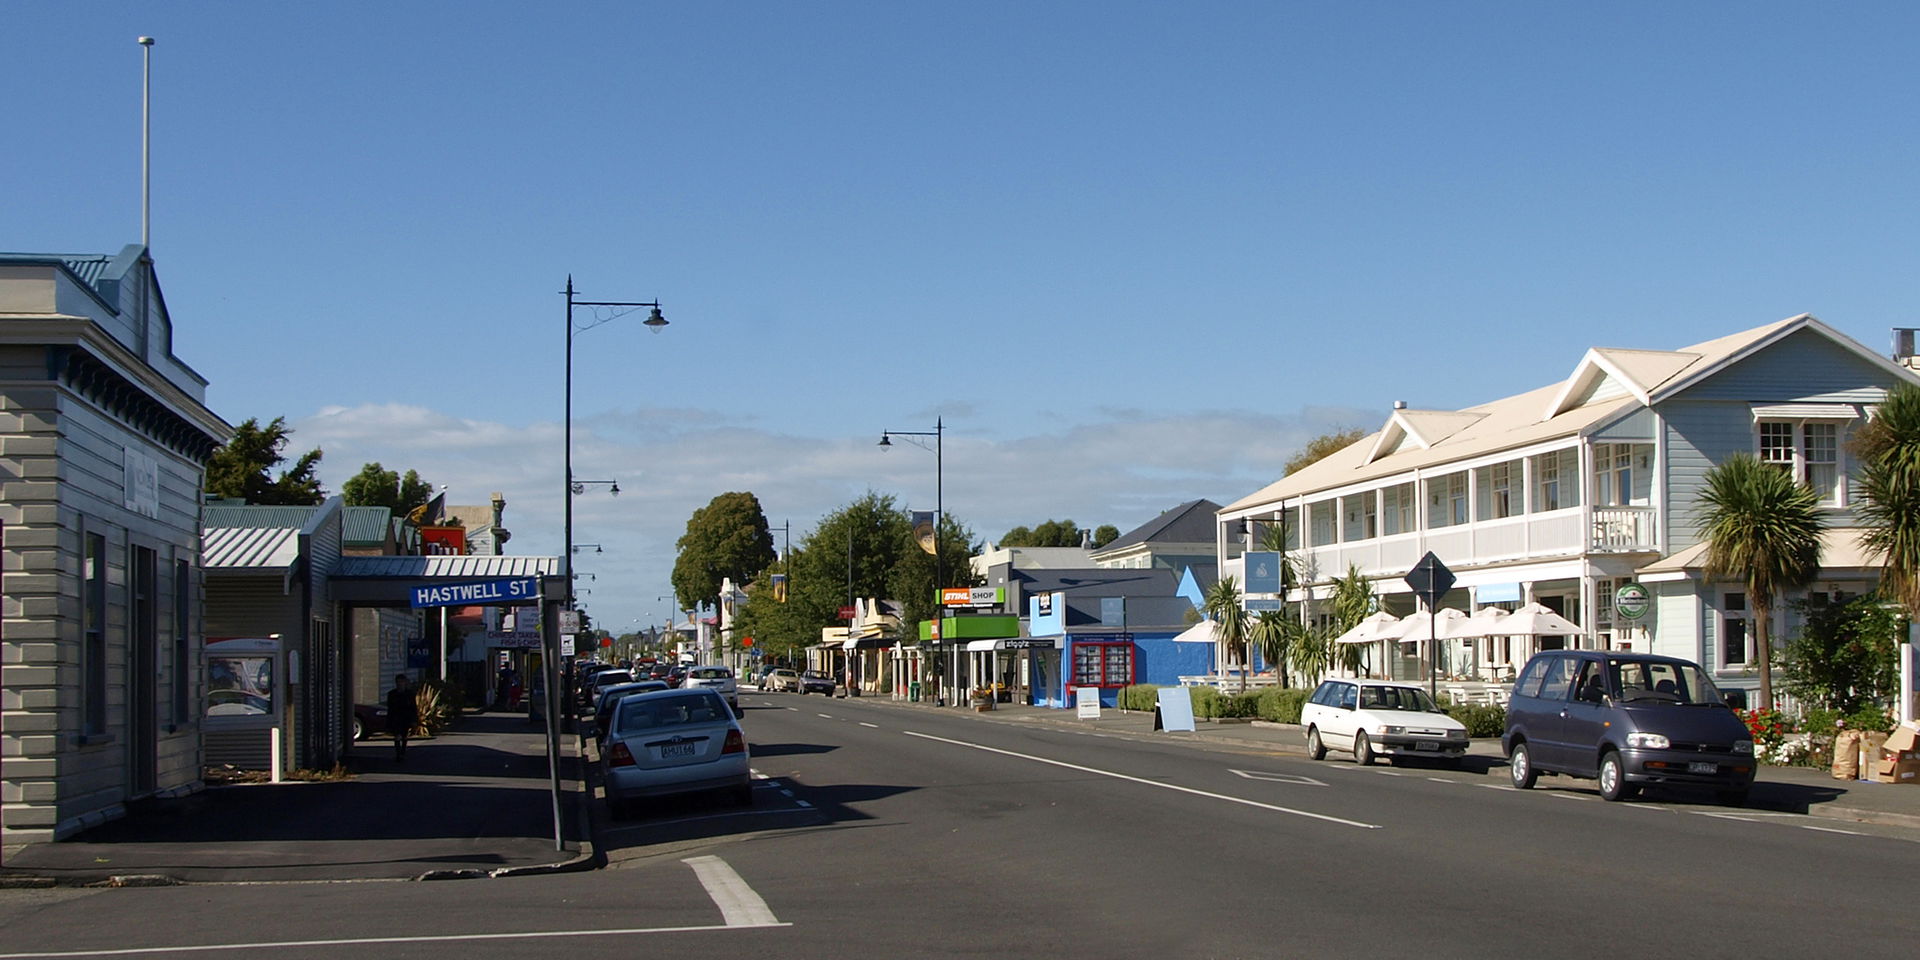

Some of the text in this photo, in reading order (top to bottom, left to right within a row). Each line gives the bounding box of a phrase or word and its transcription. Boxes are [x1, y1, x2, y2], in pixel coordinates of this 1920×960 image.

[417, 580, 529, 604] HASTWELL ST
[943, 591, 994, 601] STIHL SHOP
